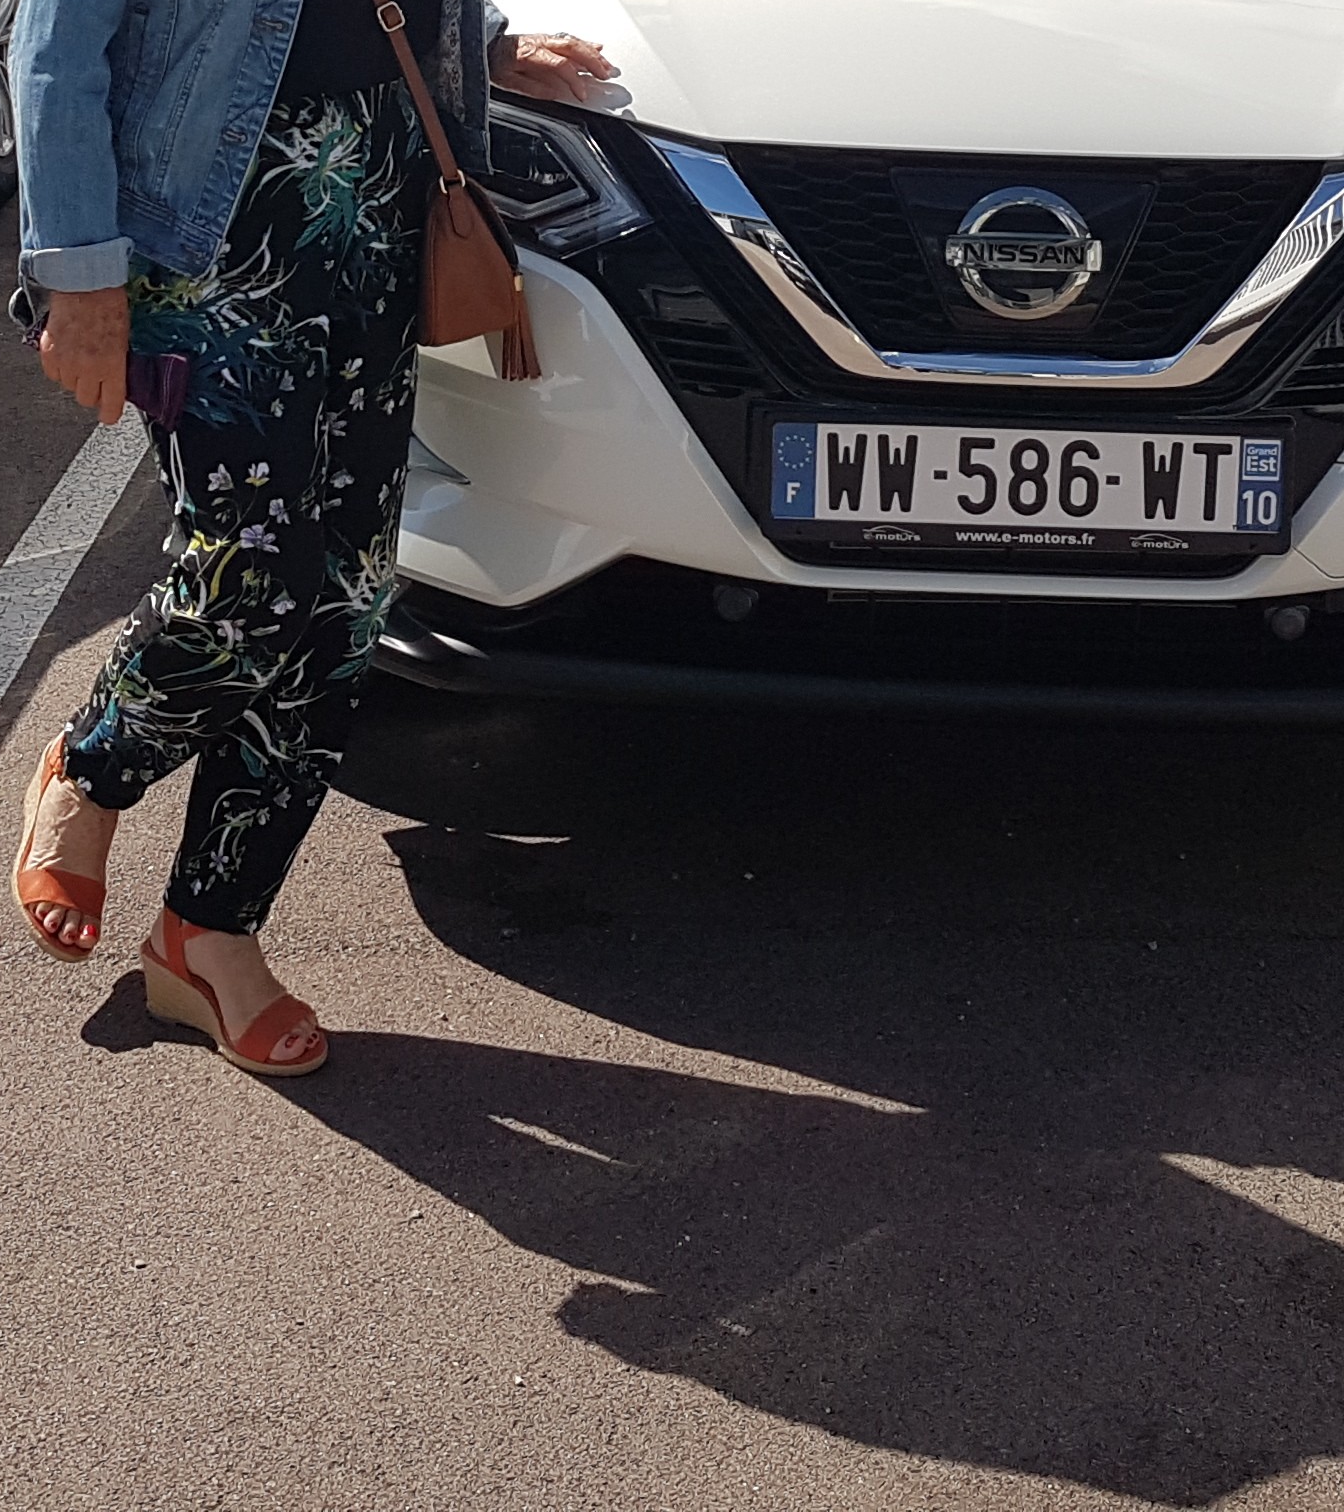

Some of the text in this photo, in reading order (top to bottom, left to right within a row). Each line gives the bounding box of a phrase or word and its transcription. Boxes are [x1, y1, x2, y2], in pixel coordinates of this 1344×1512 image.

[963, 242, 1085, 265] NISSAN
[1247, 446, 1278, 455] Grand
[1246, 455, 1276, 472] Est
[785, 482, 799, 504] F
[1242, 490, 1277, 525] 10
[956, 531, 1095, 546] www.e-motors.fr
